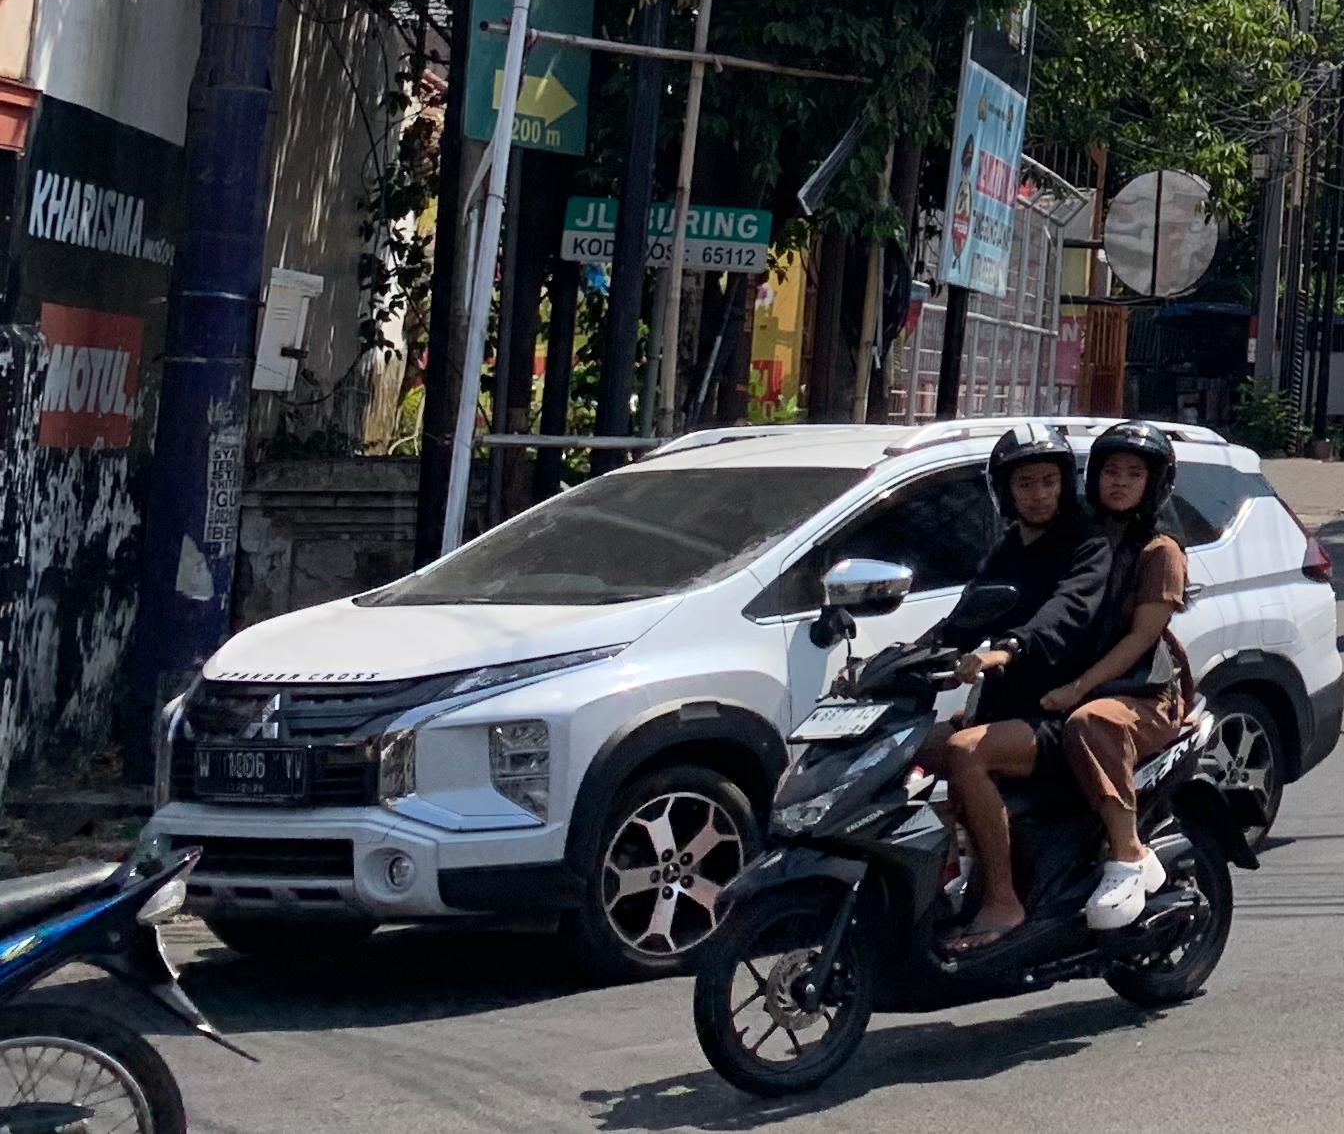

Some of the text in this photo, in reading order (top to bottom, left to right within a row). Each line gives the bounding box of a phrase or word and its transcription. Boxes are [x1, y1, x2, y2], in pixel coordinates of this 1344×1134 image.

[28, 170, 145, 259] KHARISMA
[573, 237, 615, 257] KOD
[702, 246, 756, 266] 65112
[42, 343, 131, 415] MOTUL
